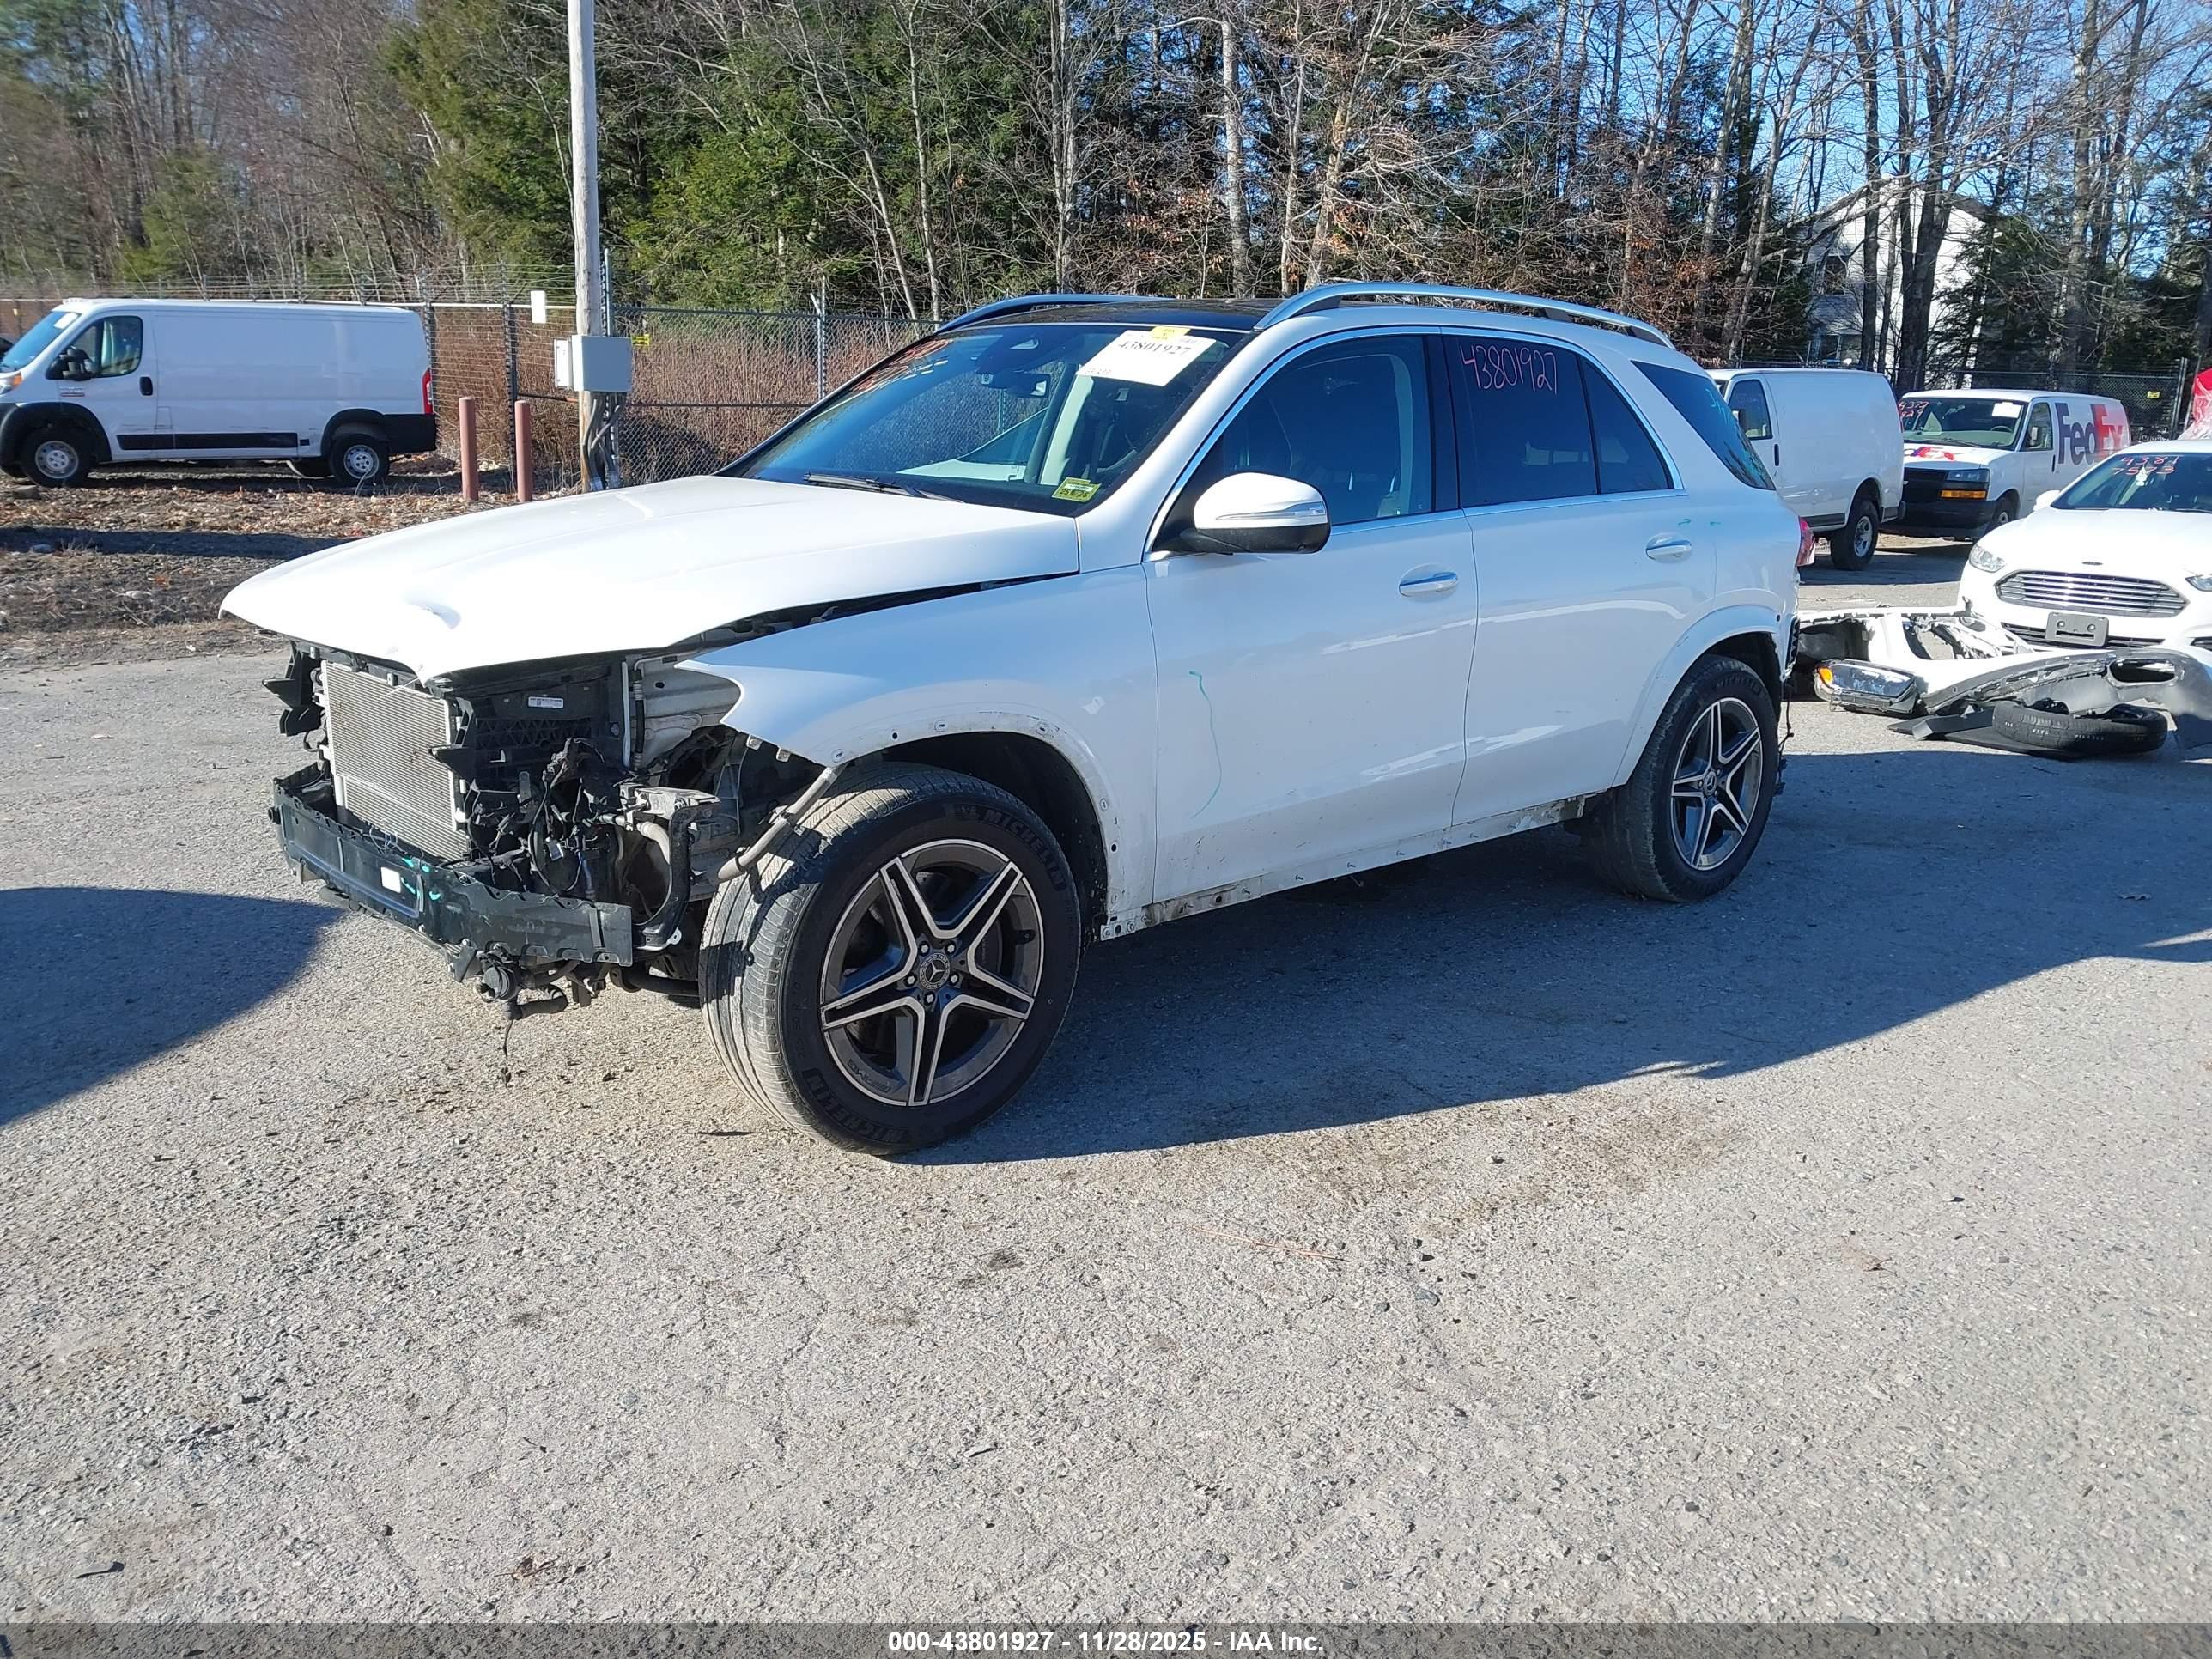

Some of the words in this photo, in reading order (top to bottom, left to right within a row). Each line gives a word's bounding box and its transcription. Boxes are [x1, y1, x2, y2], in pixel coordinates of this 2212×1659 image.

[1118, 340, 1192, 355] 43801927
[1459, 345, 1558, 395] 43801927
[1903, 447, 1964, 461] dEx
[2054, 403, 2124, 465] FedEx
[983, 808, 1066, 891] MICHELIN
